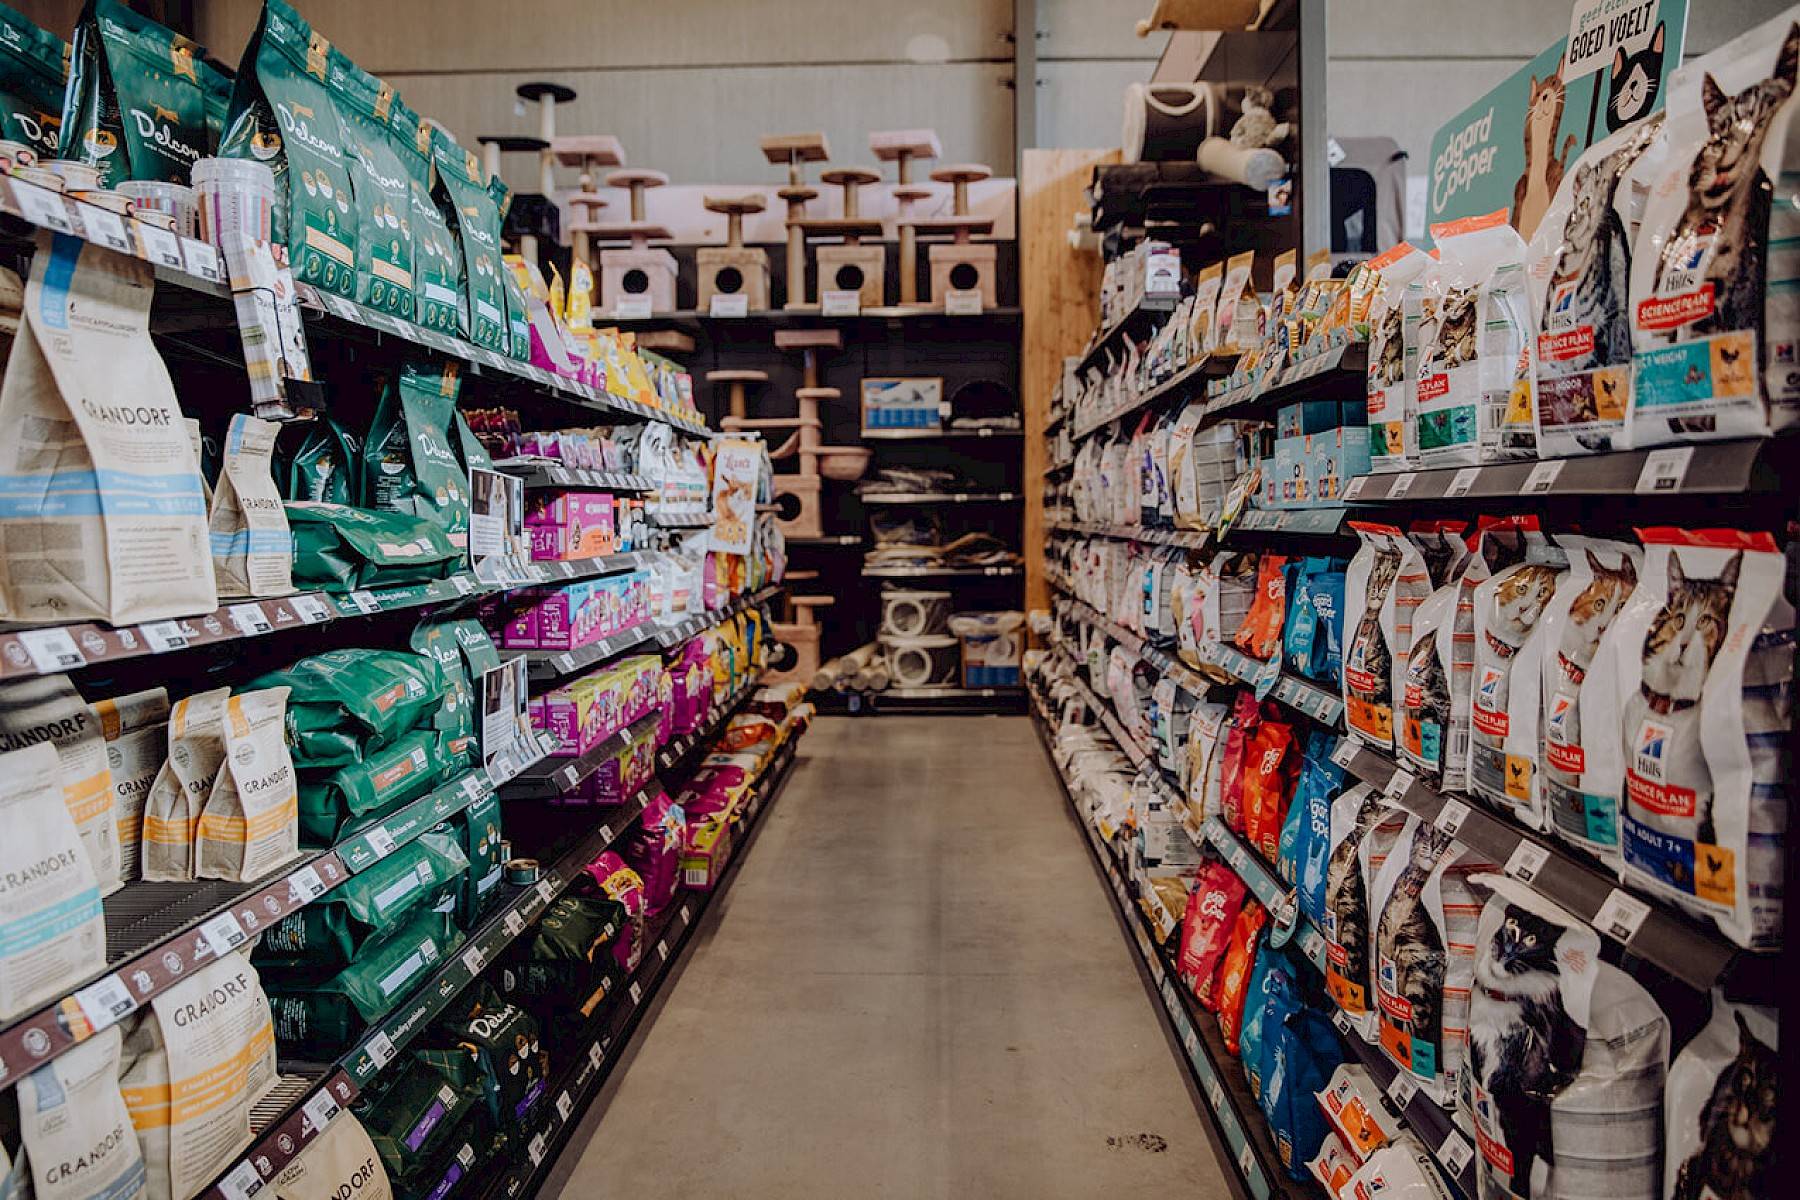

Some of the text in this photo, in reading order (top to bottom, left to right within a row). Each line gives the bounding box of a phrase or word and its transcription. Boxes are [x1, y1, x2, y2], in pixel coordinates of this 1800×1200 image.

[1569, 0, 1655, 64] GOED VOELT
[131, 108, 200, 159] Delcon
[277, 103, 341, 157] Delcon
[1434, 106, 1494, 181] edgard
[1432, 146, 1498, 214] Cooper
[1641, 301, 1681, 320] SCIENCE
[1568, 332, 1590, 346] PLAN
[82, 398, 170, 425] GRANDORF
[1656, 789, 1690, 806] PLAN
[174, 973, 248, 1028] GRANDORF
